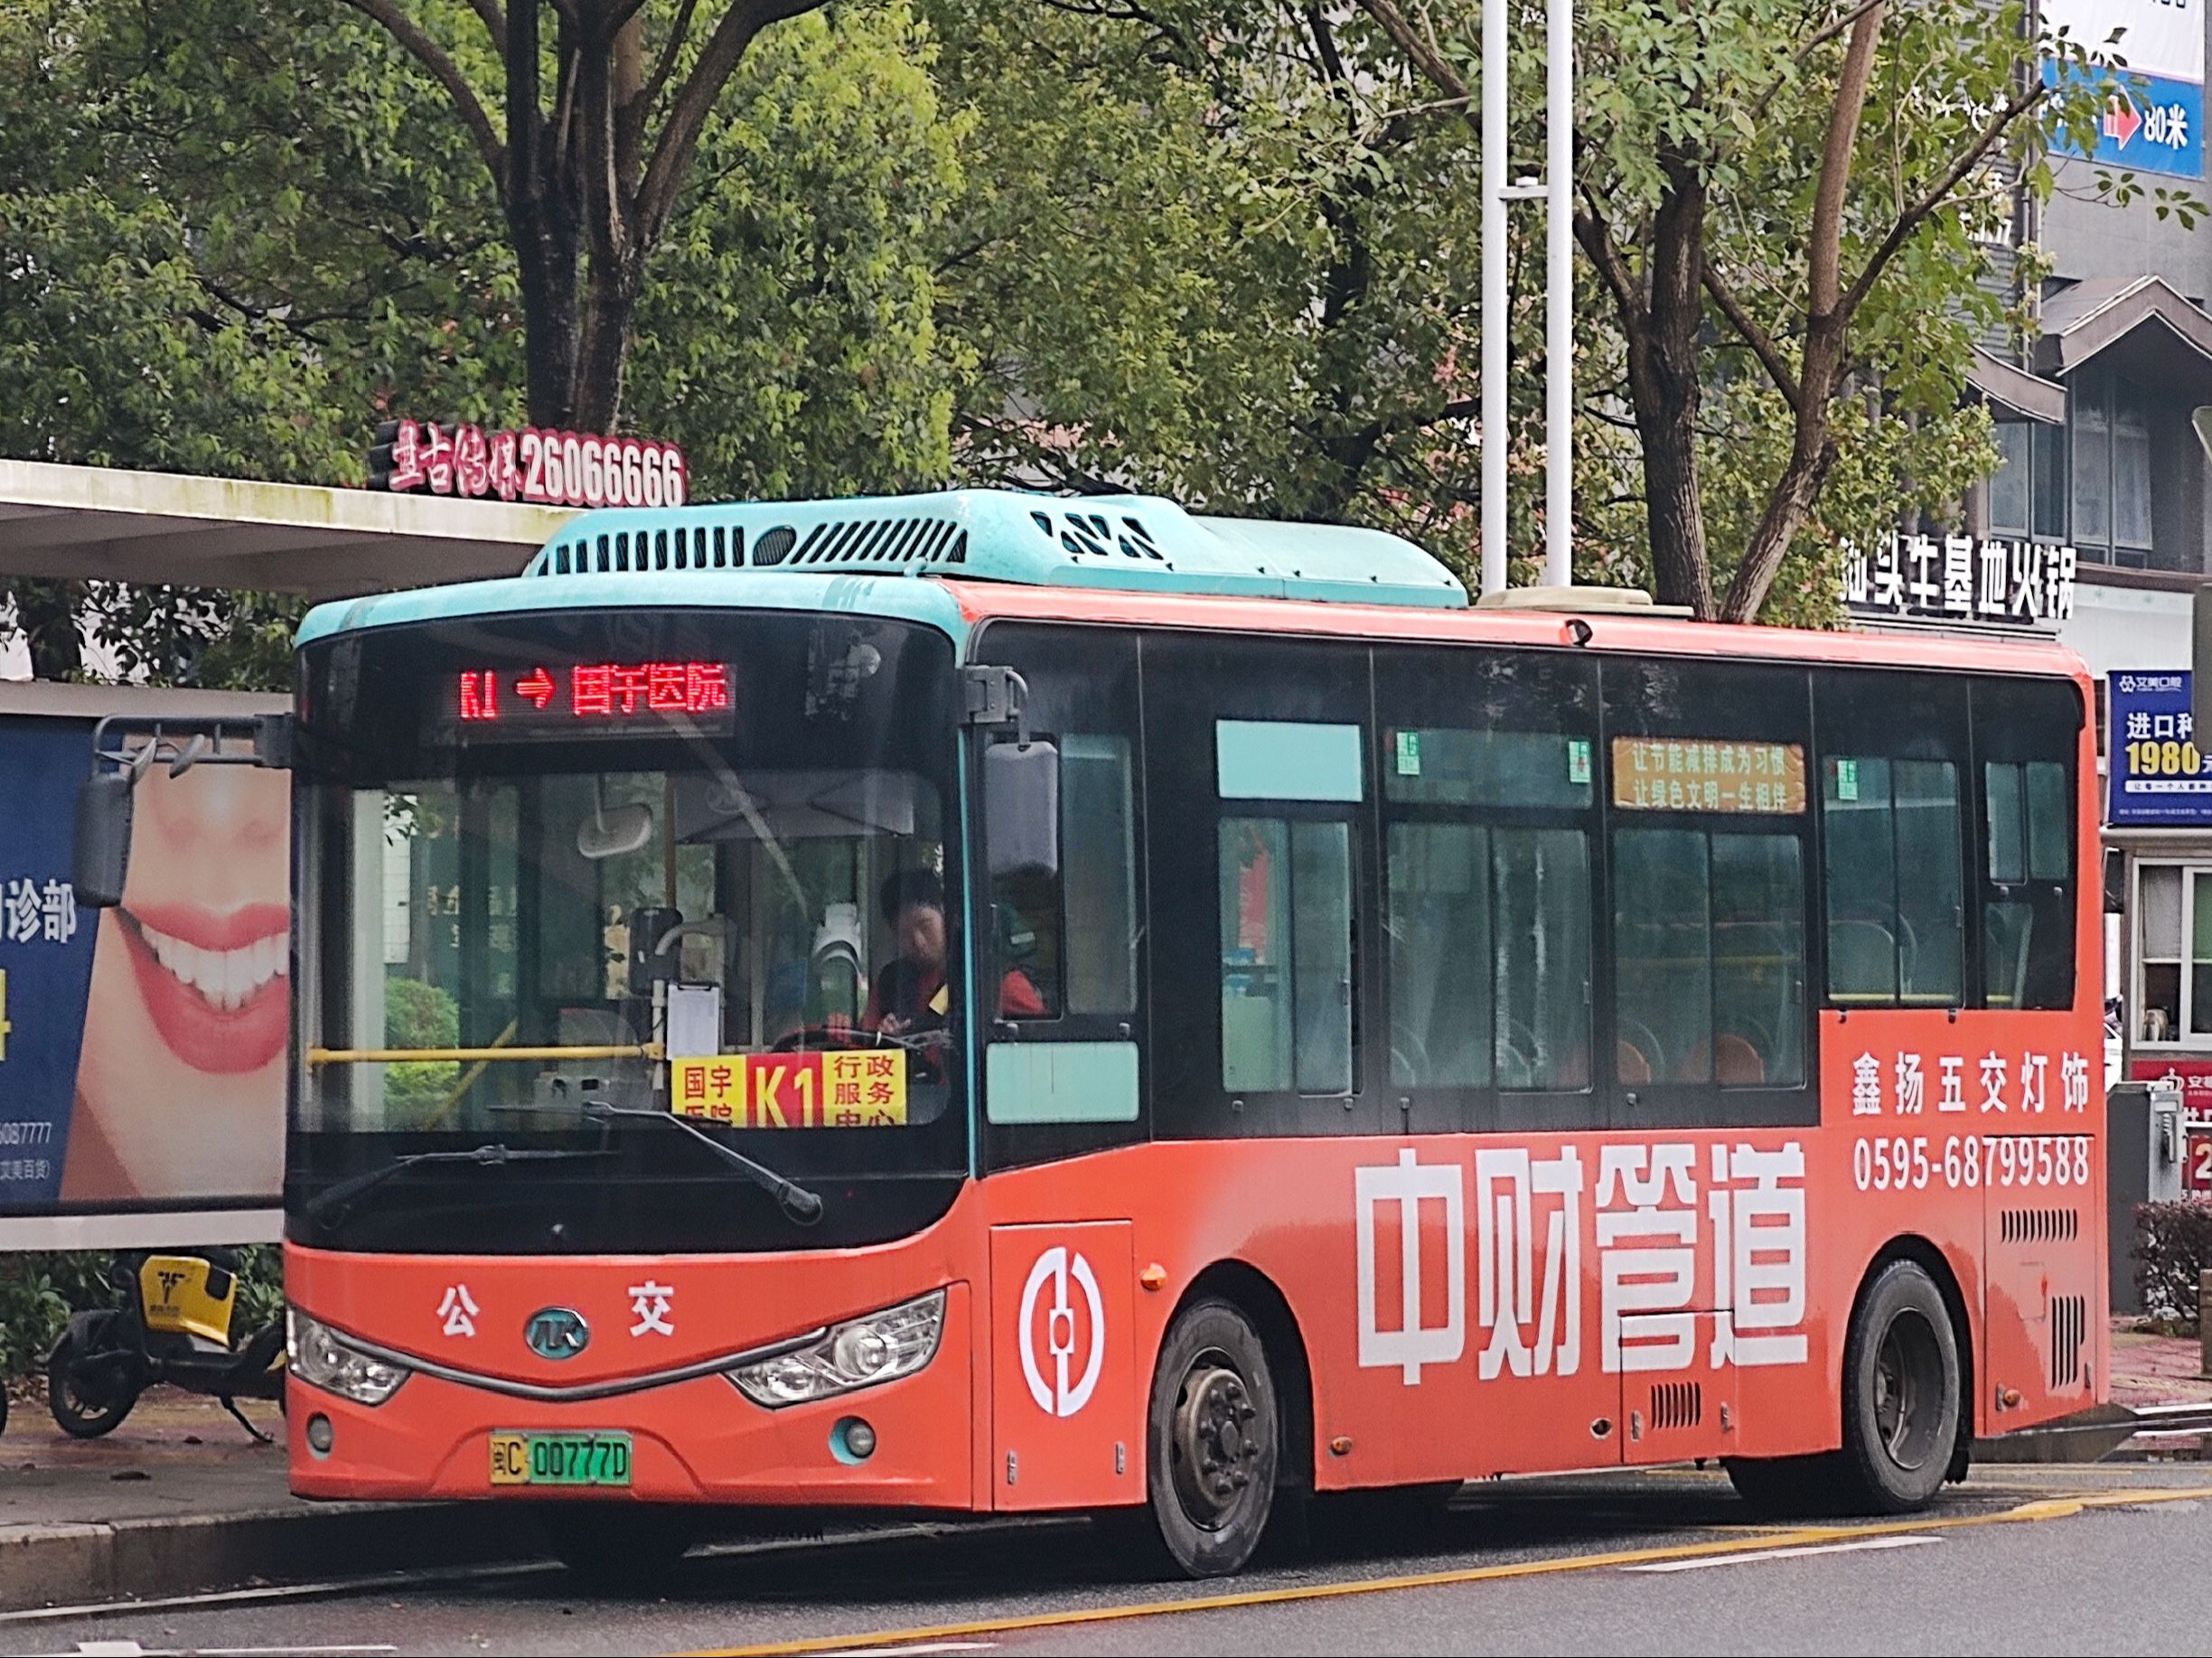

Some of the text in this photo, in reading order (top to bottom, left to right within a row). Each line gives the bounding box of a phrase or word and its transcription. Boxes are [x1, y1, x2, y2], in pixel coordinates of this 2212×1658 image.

[1632, 741, 1786, 777] 让节能减排成为习惯
[1633, 779, 1787, 811] 让绿色文明一生相伴
[0, 877, 78, 944] 诊部
[833, 1054, 895, 1079] 行政
[833, 1081, 895, 1105] 服务
[1852, 1050, 2090, 1116] 鑫扬五交灯饰
[755, 1065, 814, 1128] K1
[0, 1122, 52, 1145] 087777
[1853, 1135, 2091, 1192] 0595-68799588
[1354, 1141, 1808, 1385] 中财管道
[436, 1279, 676, 1339] 公 交
